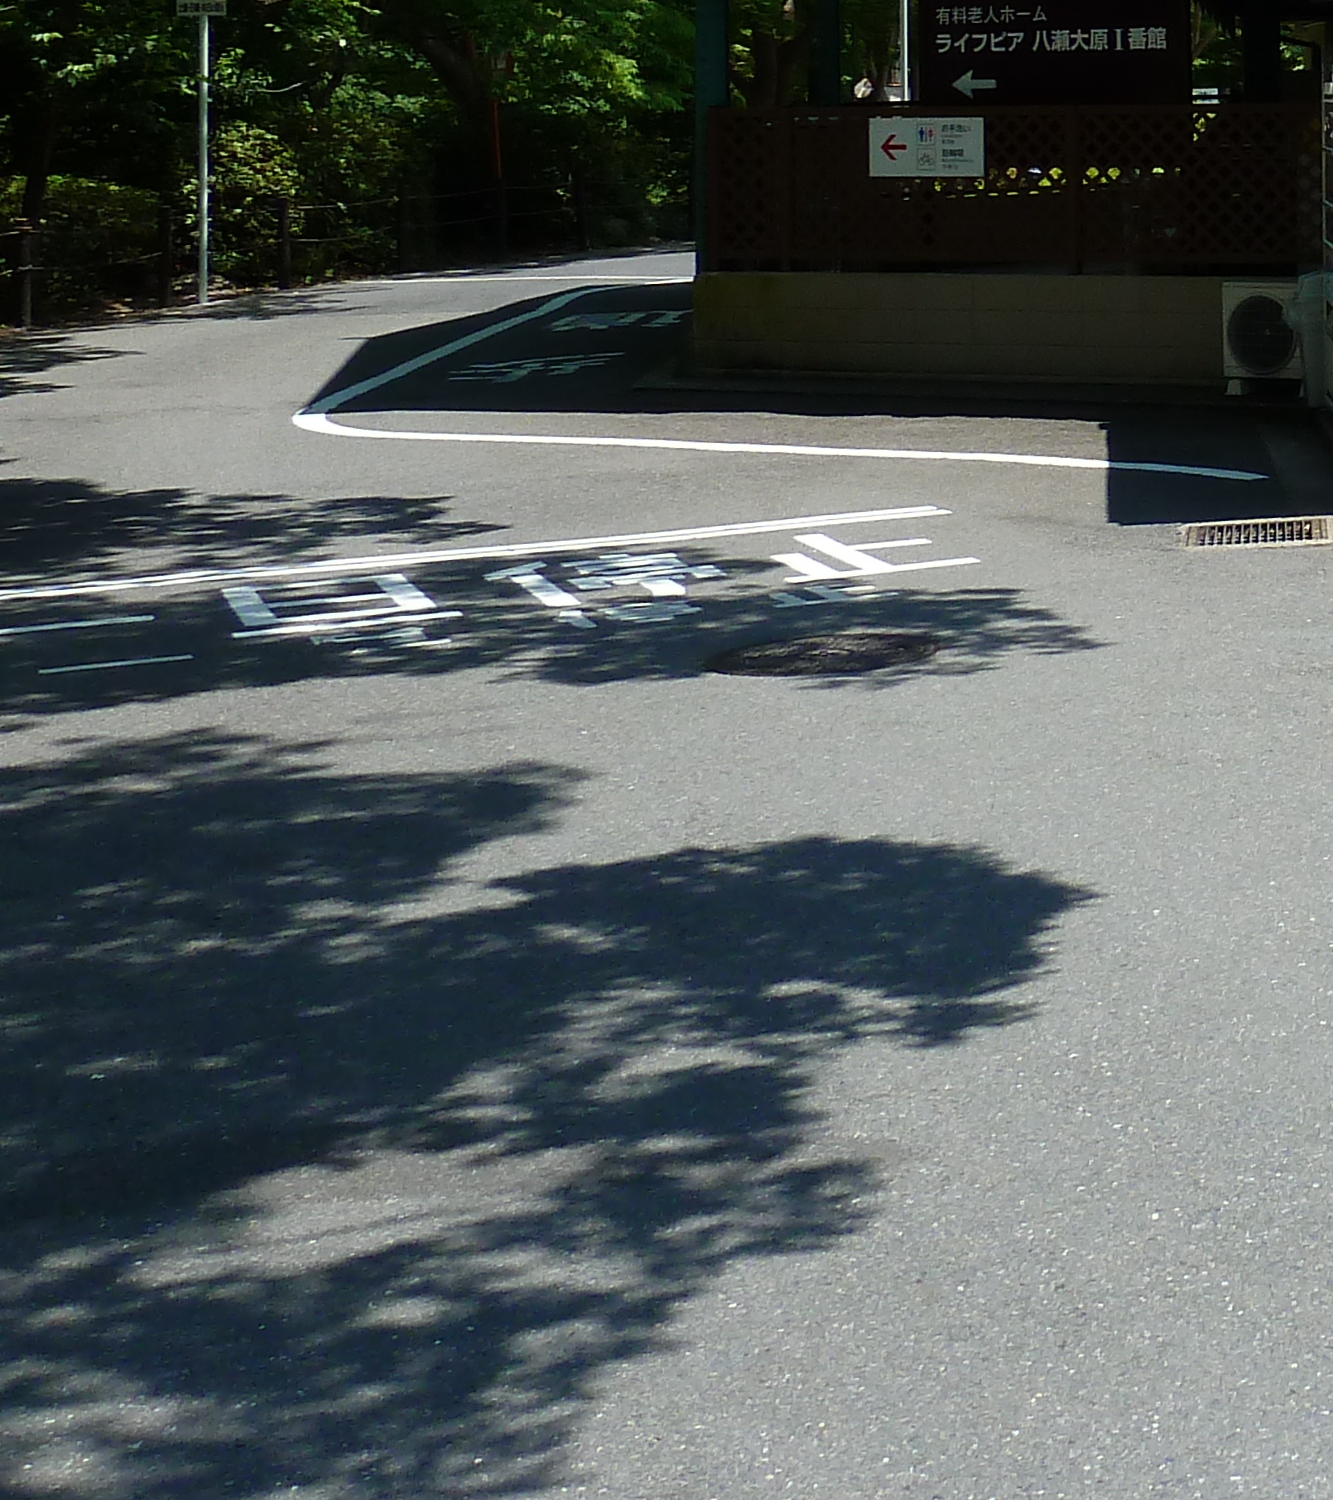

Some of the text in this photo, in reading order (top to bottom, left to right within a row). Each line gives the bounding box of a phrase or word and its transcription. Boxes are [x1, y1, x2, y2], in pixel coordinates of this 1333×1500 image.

[935, 4, 1048, 25] 有料老人ホーム
[934, 31, 1025, 54] ライフピア
